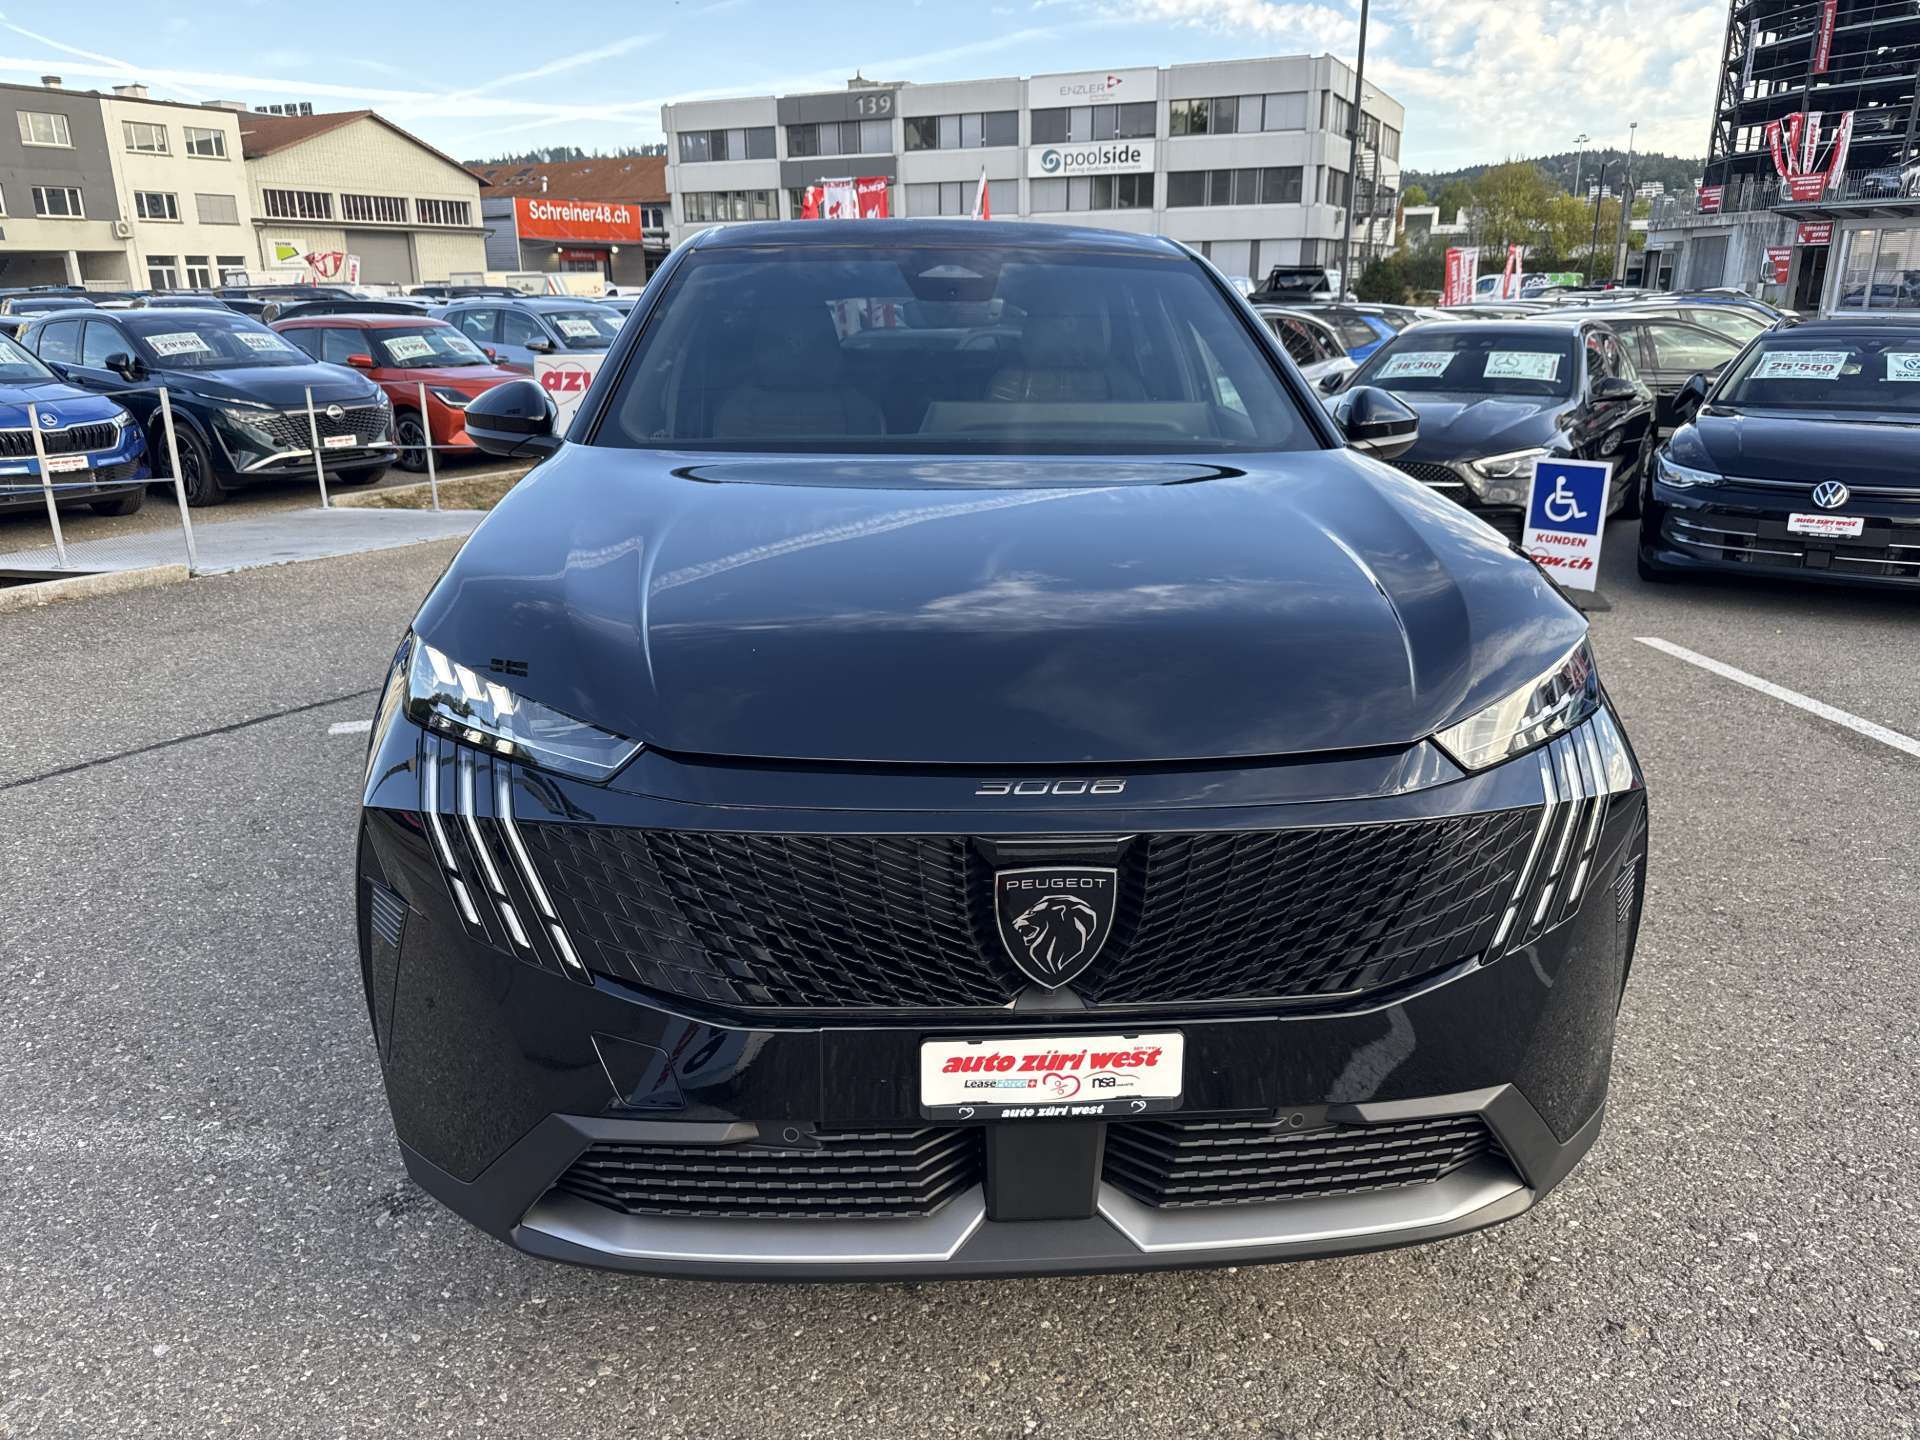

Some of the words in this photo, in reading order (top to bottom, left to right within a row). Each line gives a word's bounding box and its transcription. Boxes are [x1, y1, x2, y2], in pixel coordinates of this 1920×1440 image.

[1060, 83, 1105, 96] ENZLER
[856, 95, 891, 114] 139
[1064, 145, 1141, 173] poolside
[529, 200, 631, 224] Schreiner48.ch
[1770, 362, 1834, 371] 25'550
[1536, 533, 1587, 547] KUNDEN
[975, 779, 1127, 795] 3008
[1006, 878, 1107, 891] PEUGEOT
[942, 1052, 1016, 1073] auto
[1017, 1049, 1087, 1072] züri
[1090, 1047, 1162, 1069] west
[1092, 1077, 1116, 1089] nsa
[1001, 1108, 1035, 1118] auto
[1038, 1105, 1067, 1117] züri
[1071, 1104, 1104, 1115] west
